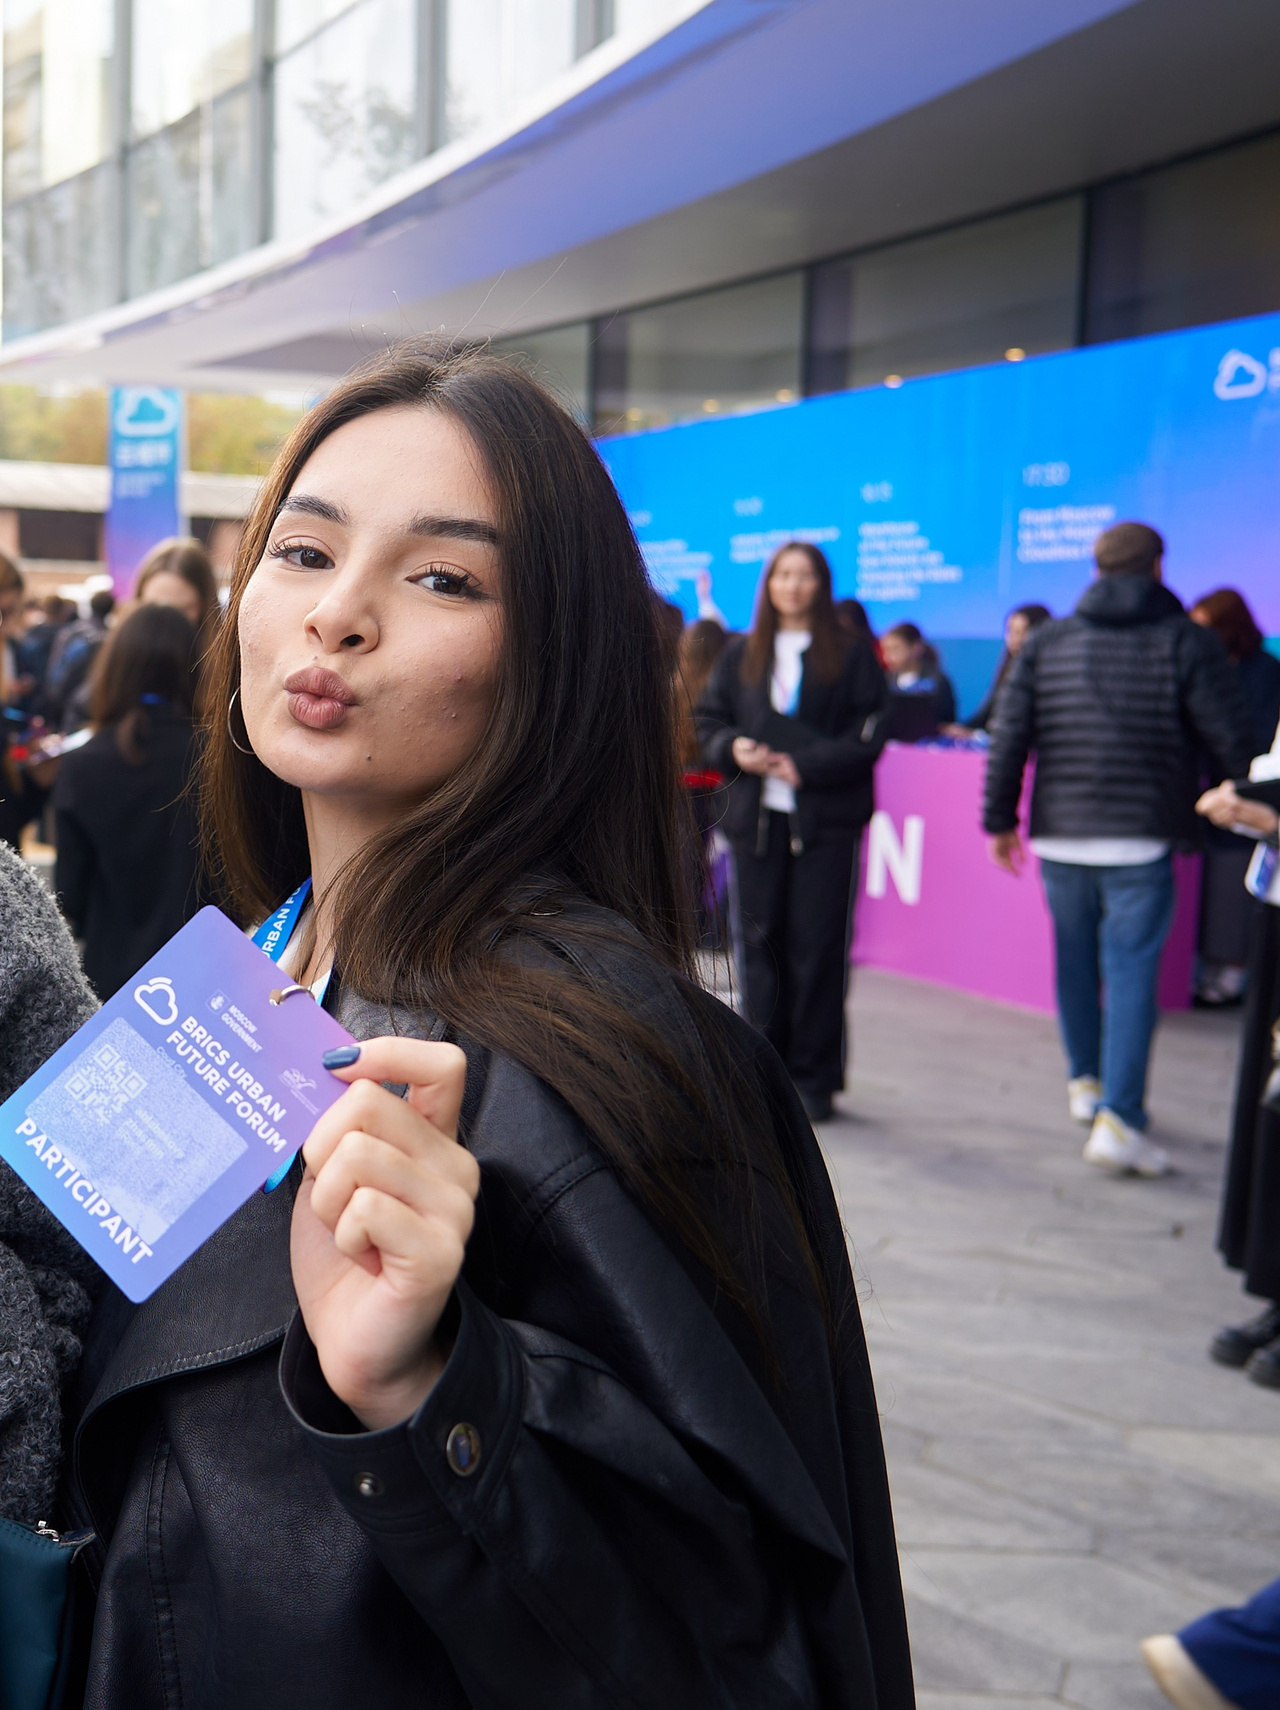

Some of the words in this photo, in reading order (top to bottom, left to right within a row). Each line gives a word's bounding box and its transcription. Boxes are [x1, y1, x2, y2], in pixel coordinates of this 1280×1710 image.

[179, 1015, 231, 1065] BRICS
[227, 1061, 287, 1122] URBAN
[221, 1012, 263, 1053] GOVERNMENT
[228, 1005, 258, 1034] MOSCOW
[166, 1030, 231, 1096] FUTURE
[226, 1090, 287, 1153] FORUM
[15, 1118, 154, 1264] PARTICIPANT
